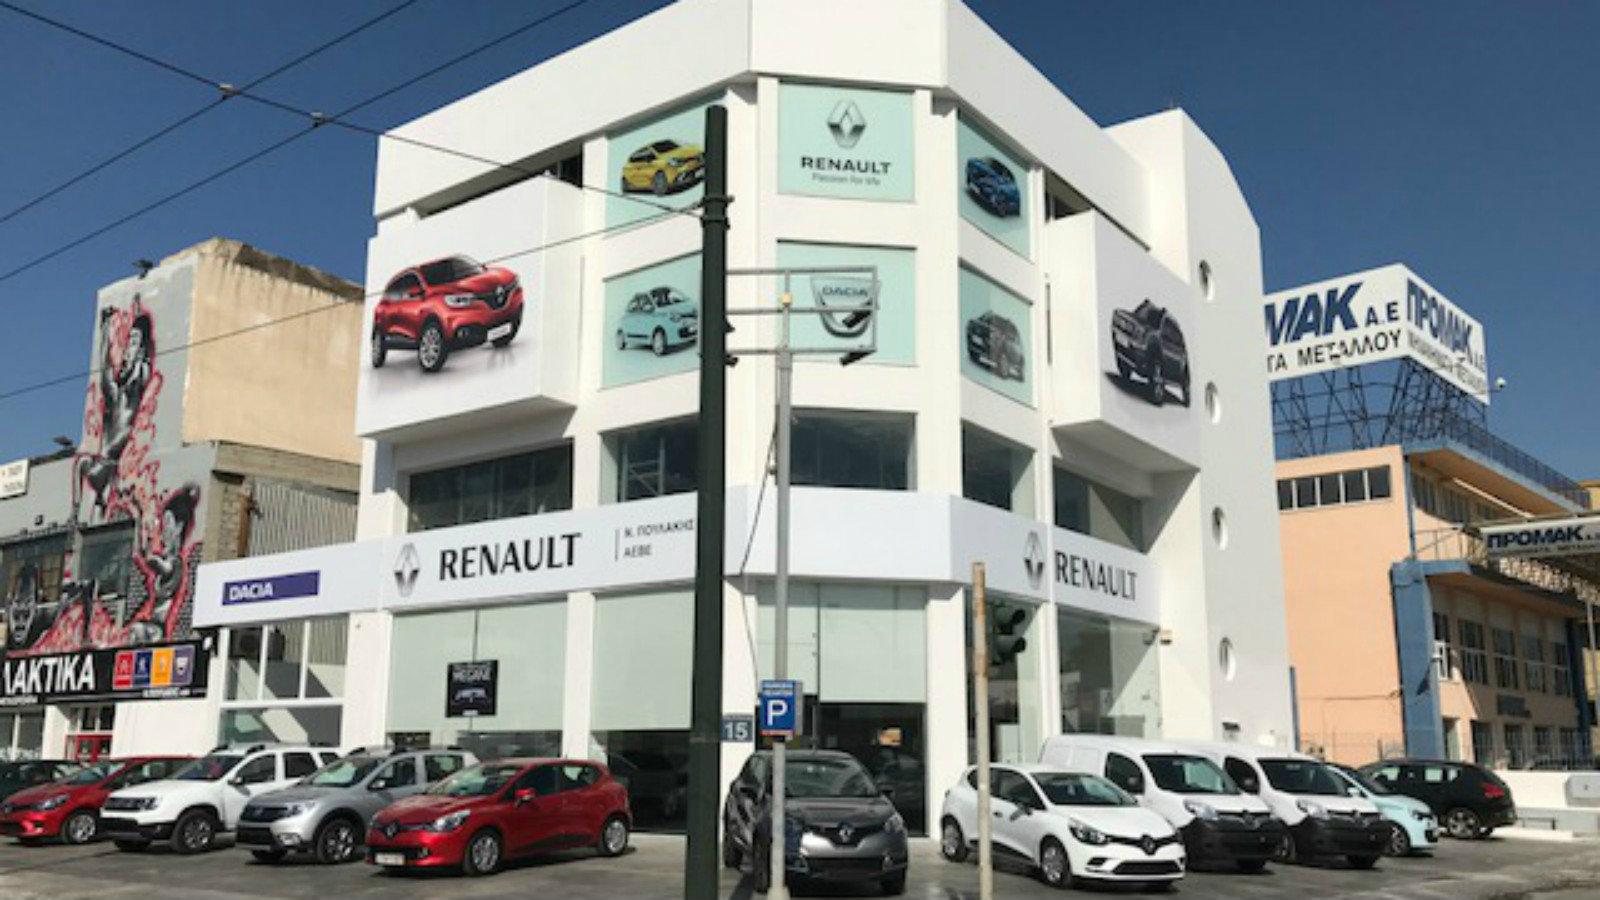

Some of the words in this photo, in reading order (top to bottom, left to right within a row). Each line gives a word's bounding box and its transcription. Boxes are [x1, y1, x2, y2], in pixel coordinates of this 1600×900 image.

[801, 157, 891, 175] RENAULT
[822, 287, 868, 297] DACIA
[1487, 525, 1583, 548] ΠΡΟΜΑΚ
[438, 532, 582, 581] RENAULT
[1055, 550, 1137, 600] RENAULT
[229, 581, 274, 602] DACIA
[767, 700, 788, 726] P
[725, 722, 749, 740] 15
